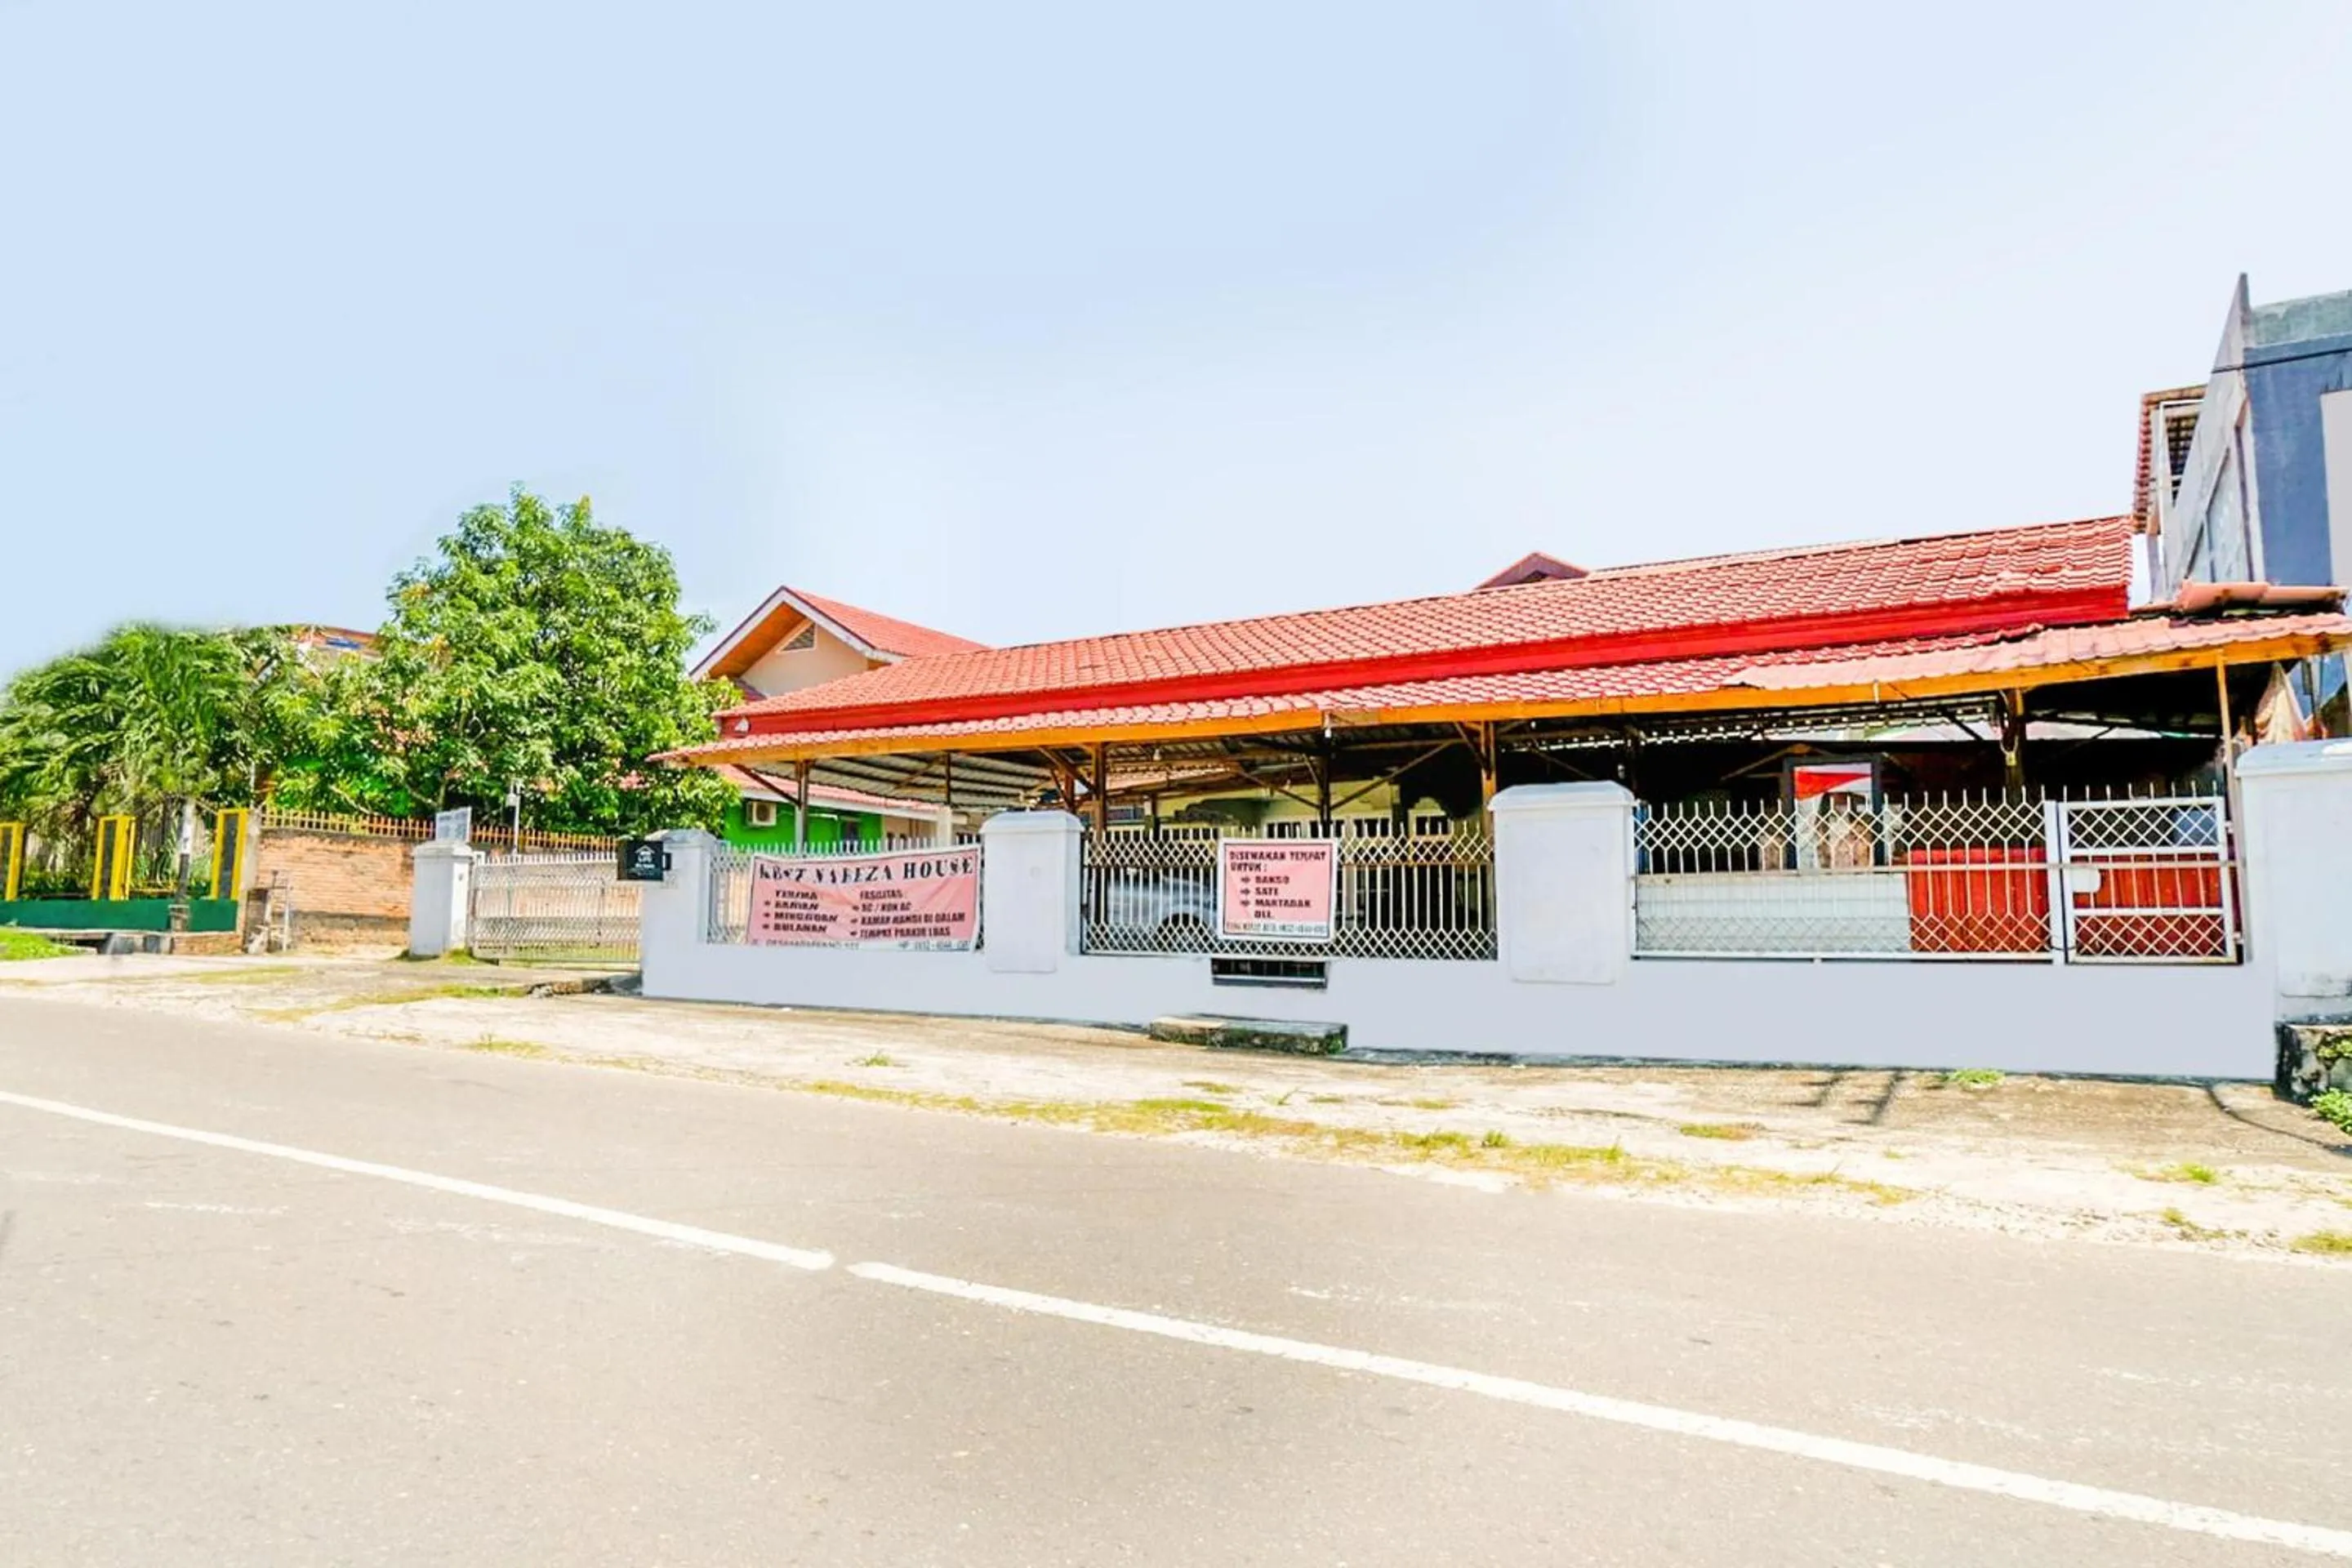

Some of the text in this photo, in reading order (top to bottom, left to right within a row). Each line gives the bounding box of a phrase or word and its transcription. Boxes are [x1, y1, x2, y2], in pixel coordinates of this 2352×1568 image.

[1229, 851, 1326, 861] DISEWAKAN TEMPAT
[903, 858, 973, 880] HOUSE
[1254, 875, 1290, 884] BAKSO
[1254, 888, 1279, 896] SATE
[1254, 899, 1311, 907] MARTABAK
